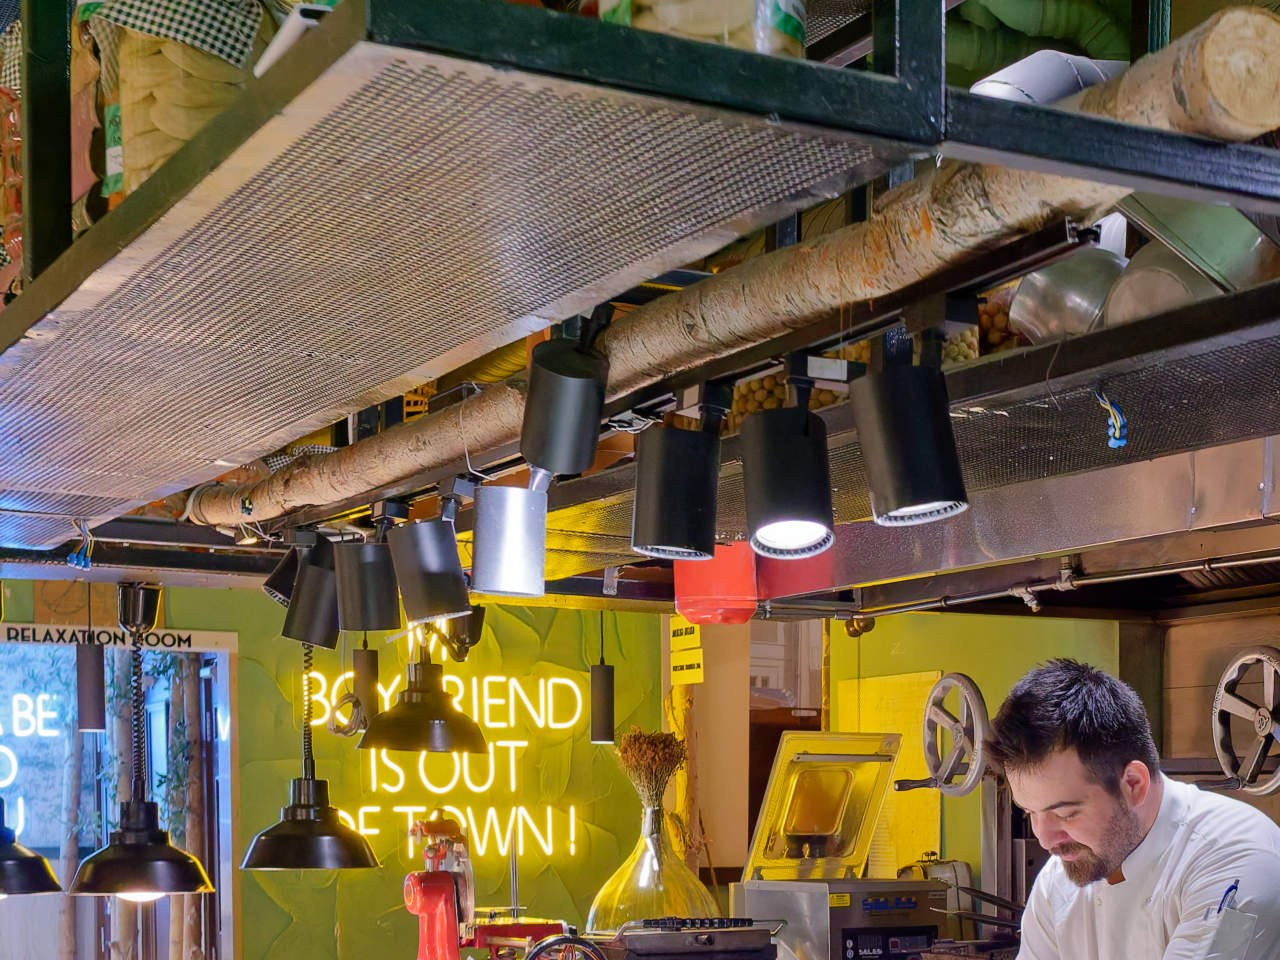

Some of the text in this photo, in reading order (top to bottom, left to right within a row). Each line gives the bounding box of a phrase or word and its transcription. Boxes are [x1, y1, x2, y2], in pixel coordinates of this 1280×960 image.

[7, 627, 126, 646] RELAXATION
[302, 670, 583, 729] BOYRIEND
[369, 740, 529, 794] IS OUT
